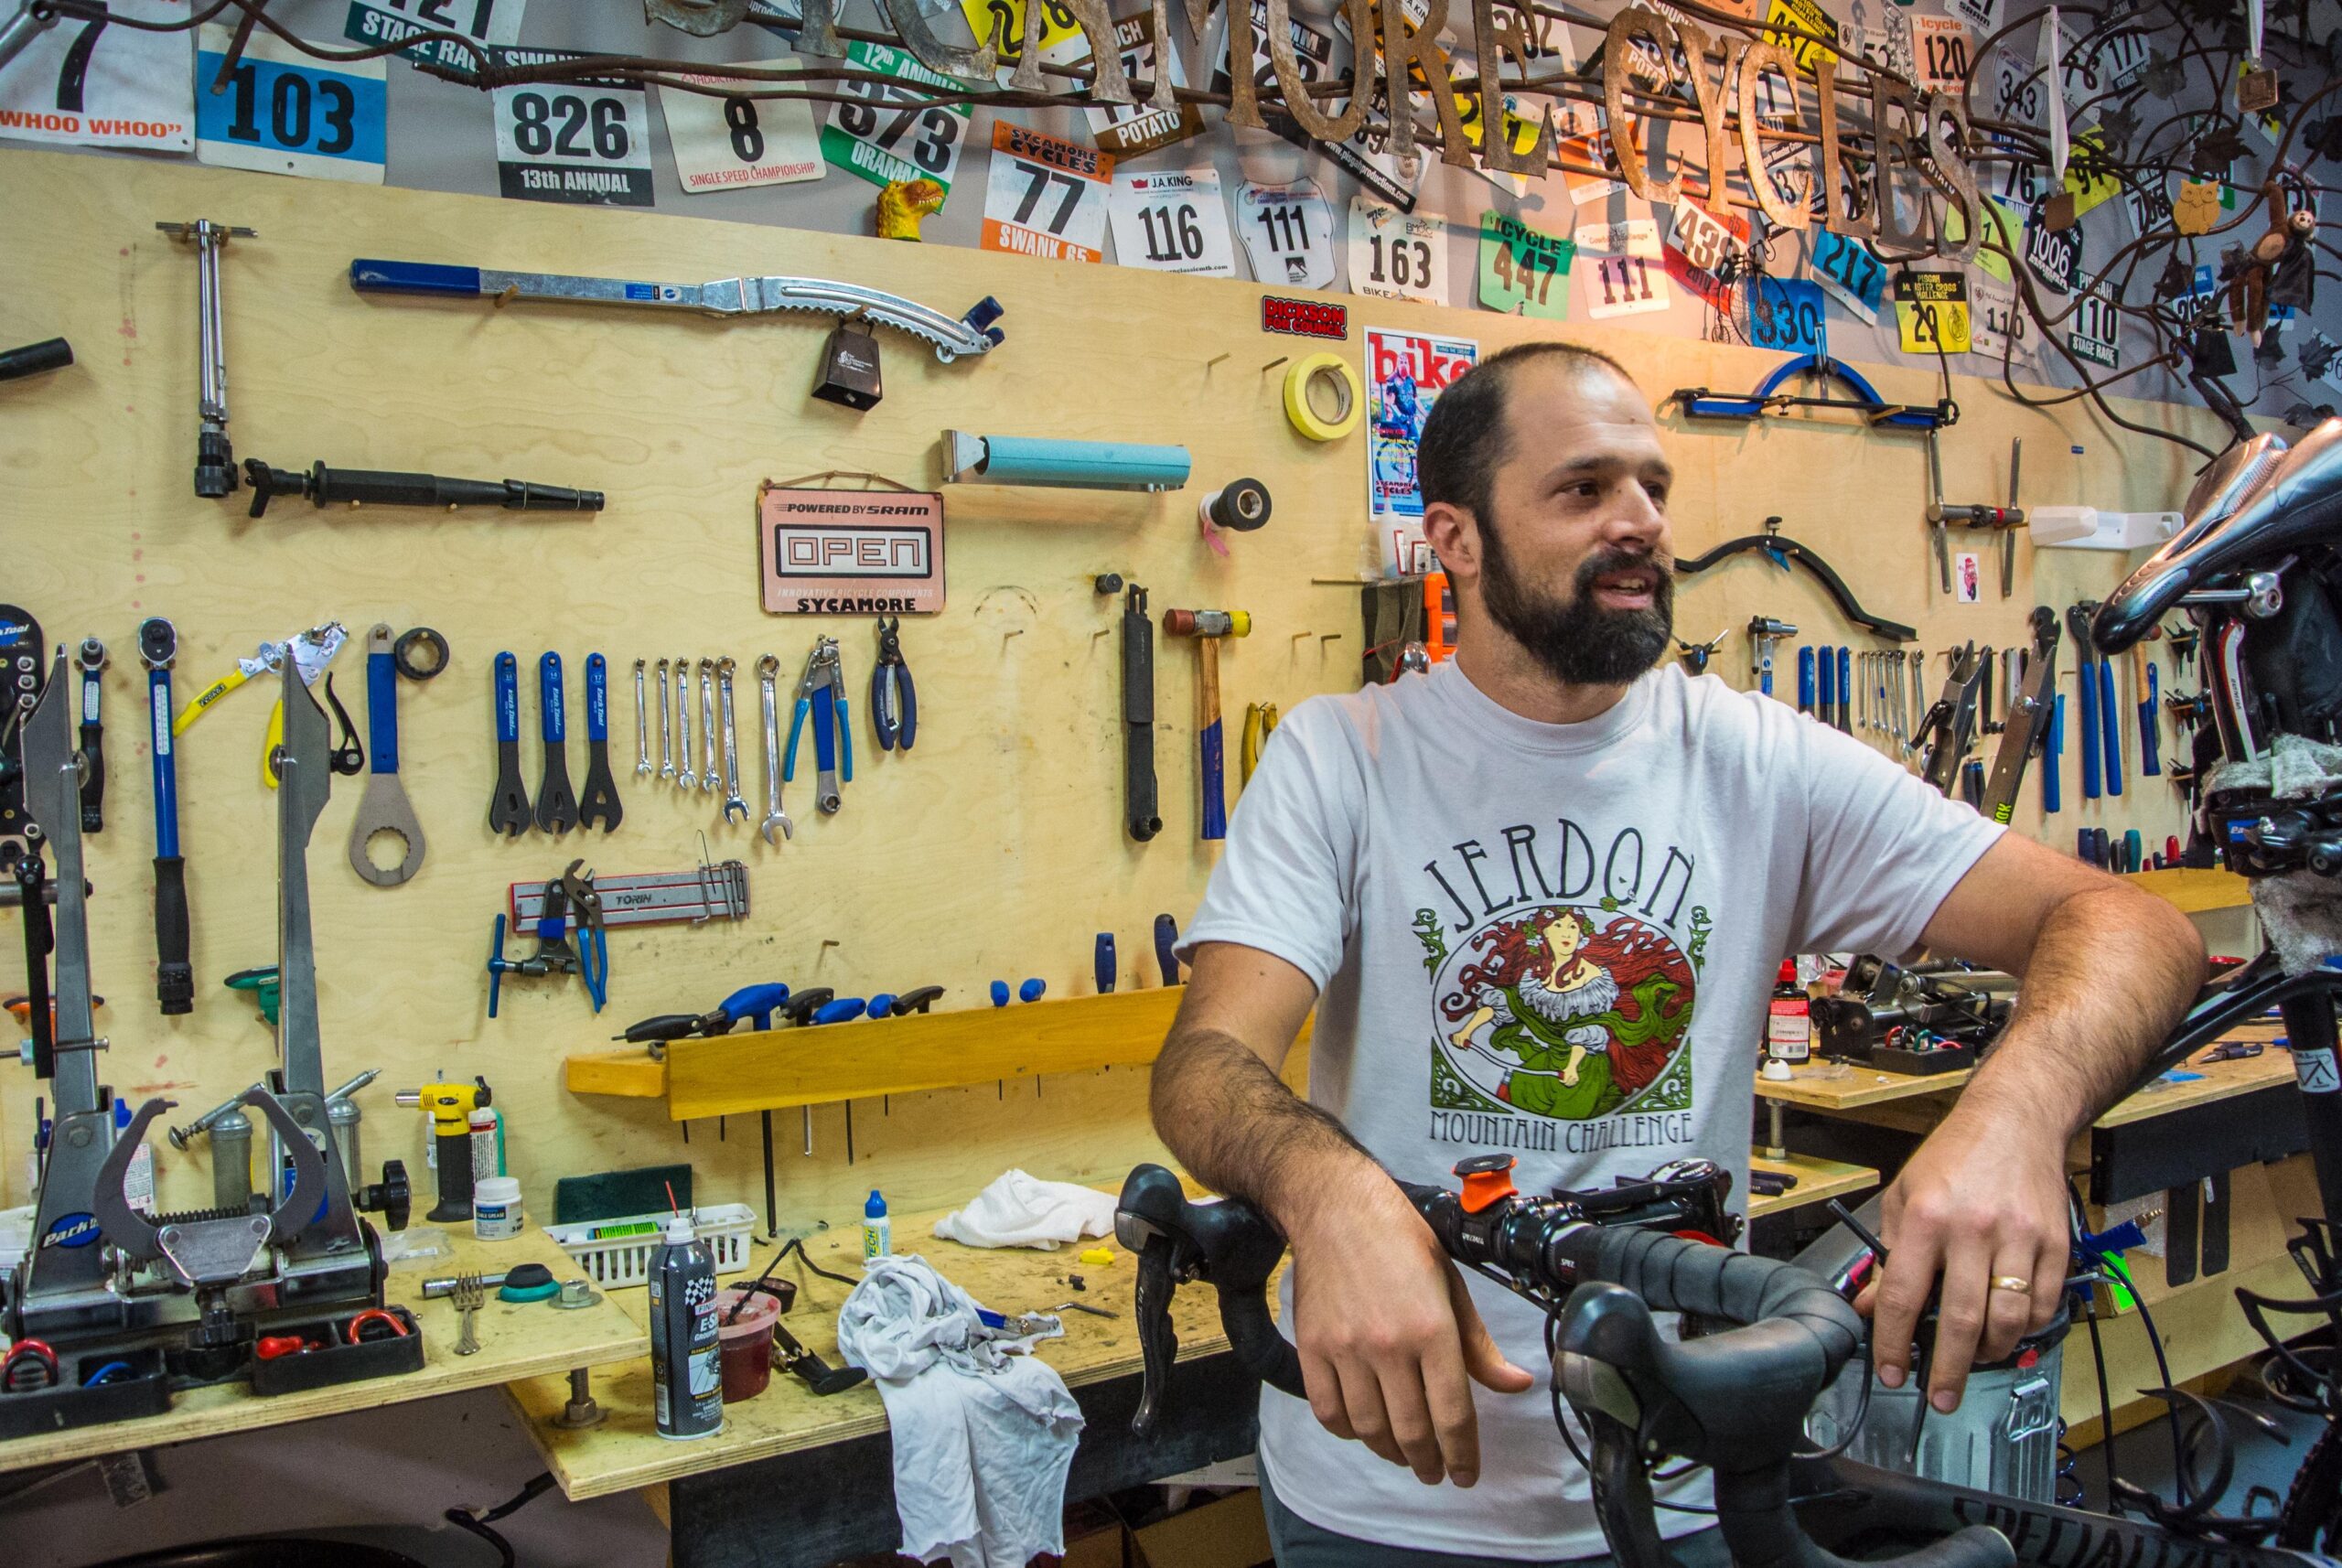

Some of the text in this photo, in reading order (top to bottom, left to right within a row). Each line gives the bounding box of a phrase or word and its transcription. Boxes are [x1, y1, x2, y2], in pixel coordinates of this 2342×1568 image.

[1920, 16, 1962, 32] Icycle
[1958, 2, 1992, 28] SRAM
[55, 2, 108, 113] 7
[1925, 34, 1969, 81] 120
[227, 64, 355, 154] 103
[511, 91, 628, 160] 826
[837, 77, 961, 175] 573
[723, 96, 765, 163] 8
[1011, 128, 1098, 163] SYCAMORE
[1115, 111, 1181, 147] POTATO
[1601, 5, 1982, 264] CYCLES
[689, 161, 817, 188] SINGLE SPEED CHAMPIONSHIP
[1010, 139, 1097, 176] CYCLES
[1324, 139, 1410, 205] www.pisgahproductions.com
[520, 169, 631, 195] 13th ANNUAL
[1013, 158, 1087, 235] 77
[999, 224, 1058, 259] SWANK
[1137, 203, 1204, 262] 116
[1257, 204, 1310, 252] 111
[1494, 215, 1563, 255] ICYCLE
[1674, 208, 1741, 282] 438
[1370, 233, 1432, 289] 163
[1822, 231, 1879, 299] 217
[2032, 223, 2071, 278] 1006
[1362, 285, 1391, 299] BIKE
[1493, 241, 1557, 306] 447
[1598, 255, 1653, 305] 111
[1917, 274, 1941, 285] PISGAH
[1935, 284, 1957, 293] CROSS
[1263, 297, 1346, 323] DICKSON
[1915, 291, 1950, 300] HALLENGE
[1264, 318, 1345, 338] FOR COUNCIL
[1910, 304, 1939, 343] 29
[1987, 306, 2025, 340] 110
[2073, 293, 2117, 346] 110
[1368, 332, 1473, 390] bike
[2072, 336, 2094, 357] STAGE
[787, 503, 929, 516] POWERED BY SRAM
[1375, 486, 1413, 495] CYCLES
[788, 536, 920, 567] OPEN
[778, 588, 934, 598] INNOVATIVE BICYCLE COMPONENTS
[797, 597, 916, 613] SYCAMORE
[1423, 818, 1695, 933] JERDON
[616, 893, 652, 907] TORIN
[1429, 1110, 1694, 1155] MOUNTAIN CHALLENGE
[43, 1219, 89, 1248] Park
